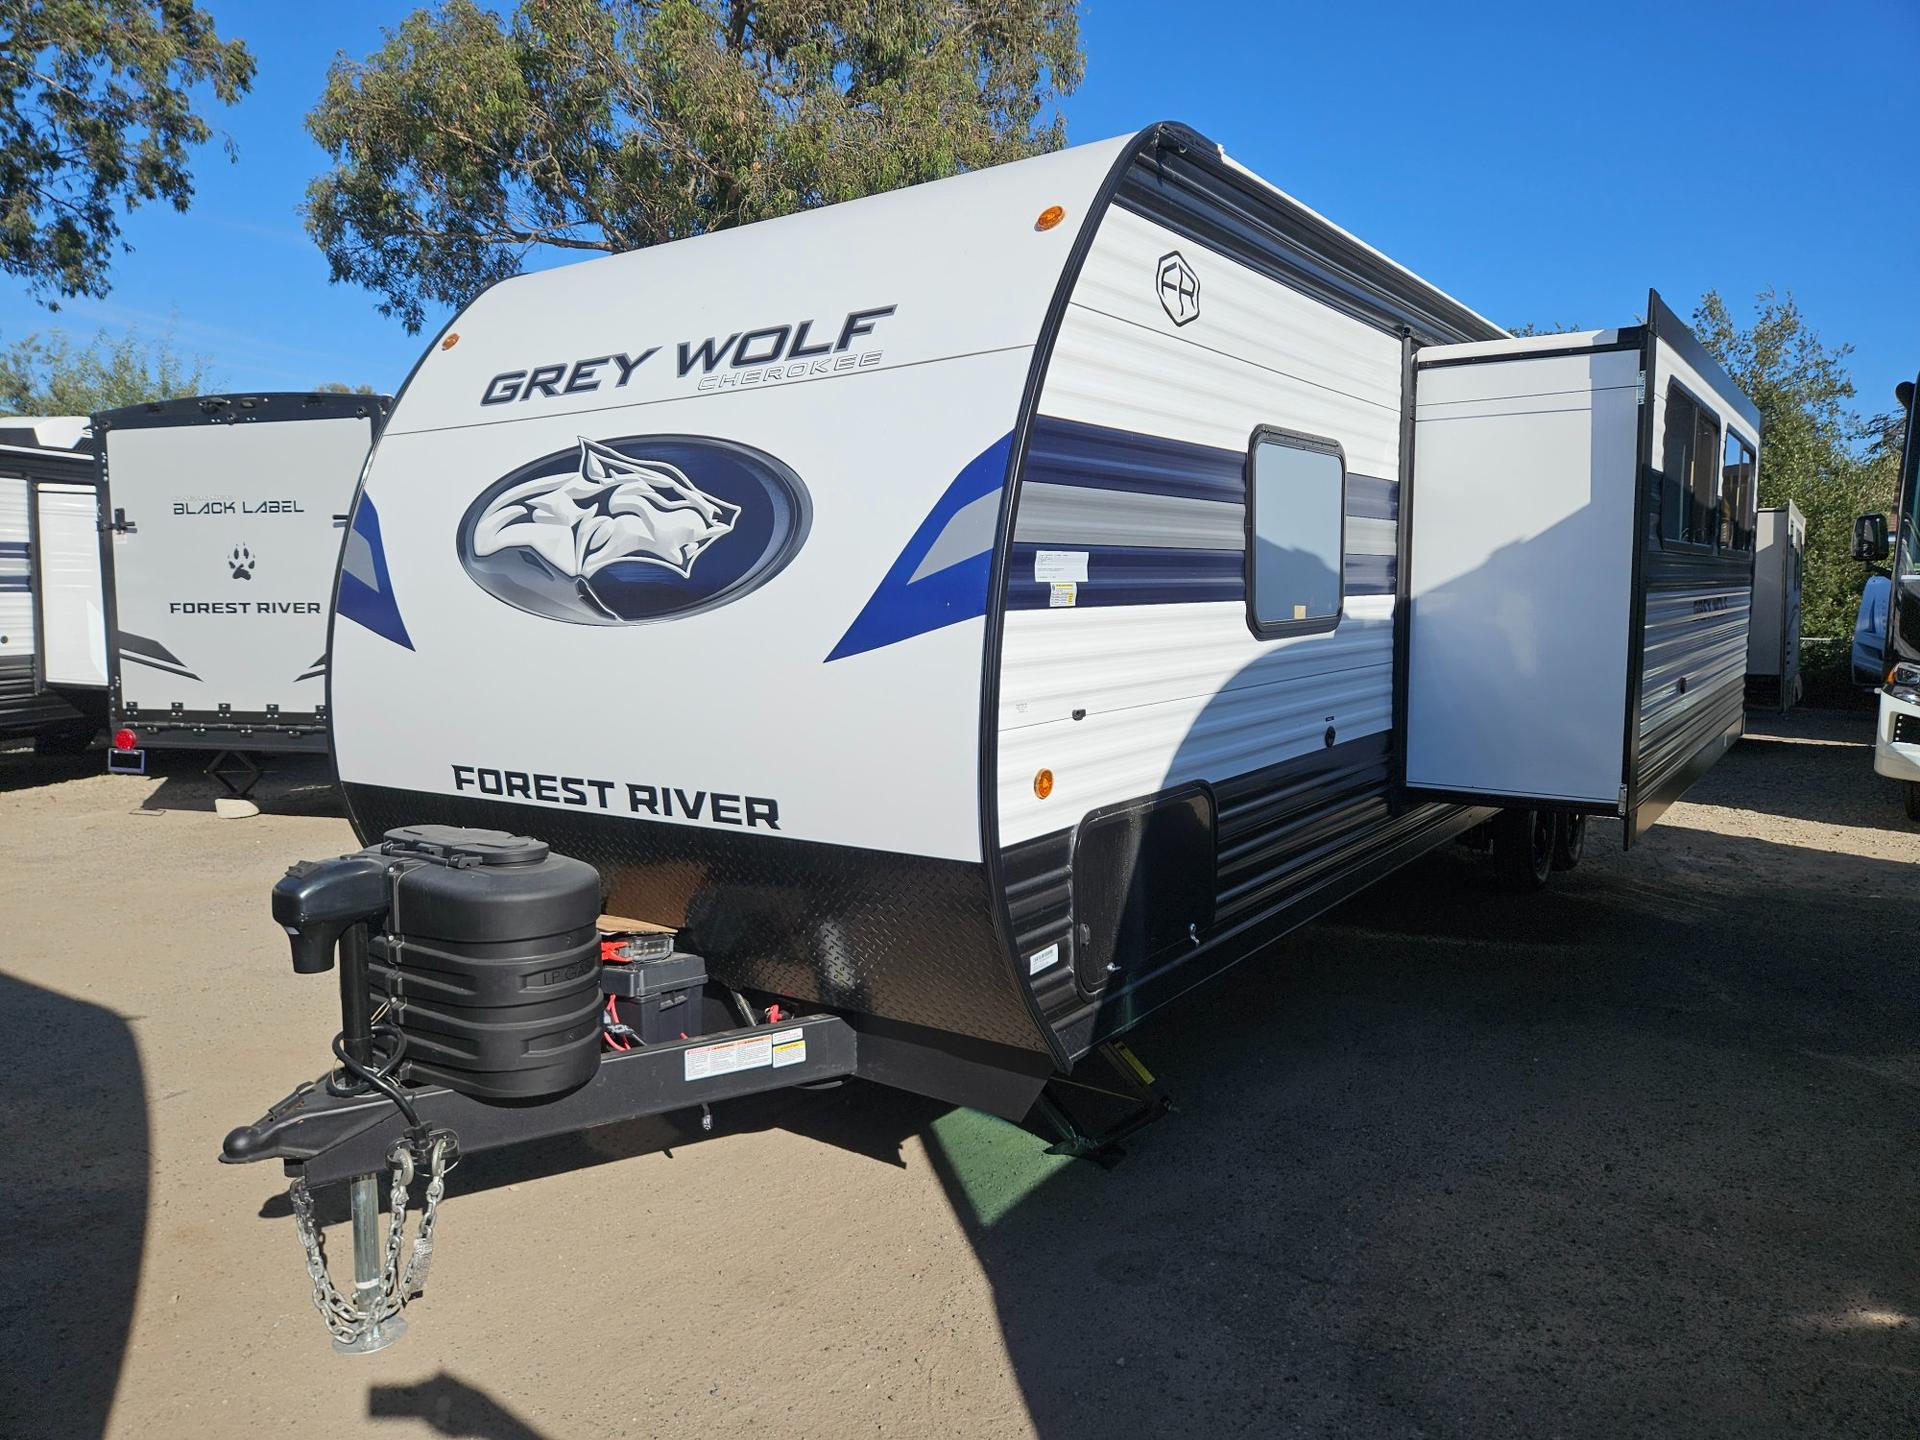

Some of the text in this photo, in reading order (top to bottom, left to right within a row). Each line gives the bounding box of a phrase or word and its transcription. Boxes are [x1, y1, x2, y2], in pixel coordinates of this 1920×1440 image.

[479, 303, 899, 407] GREY WOLF
[698, 350, 884, 391] CHEROKEE
[173, 499, 305, 515] BLACK LABEL
[169, 602, 321, 614] FOREST RIVER
[451, 764, 782, 831] FOREST RIVER
